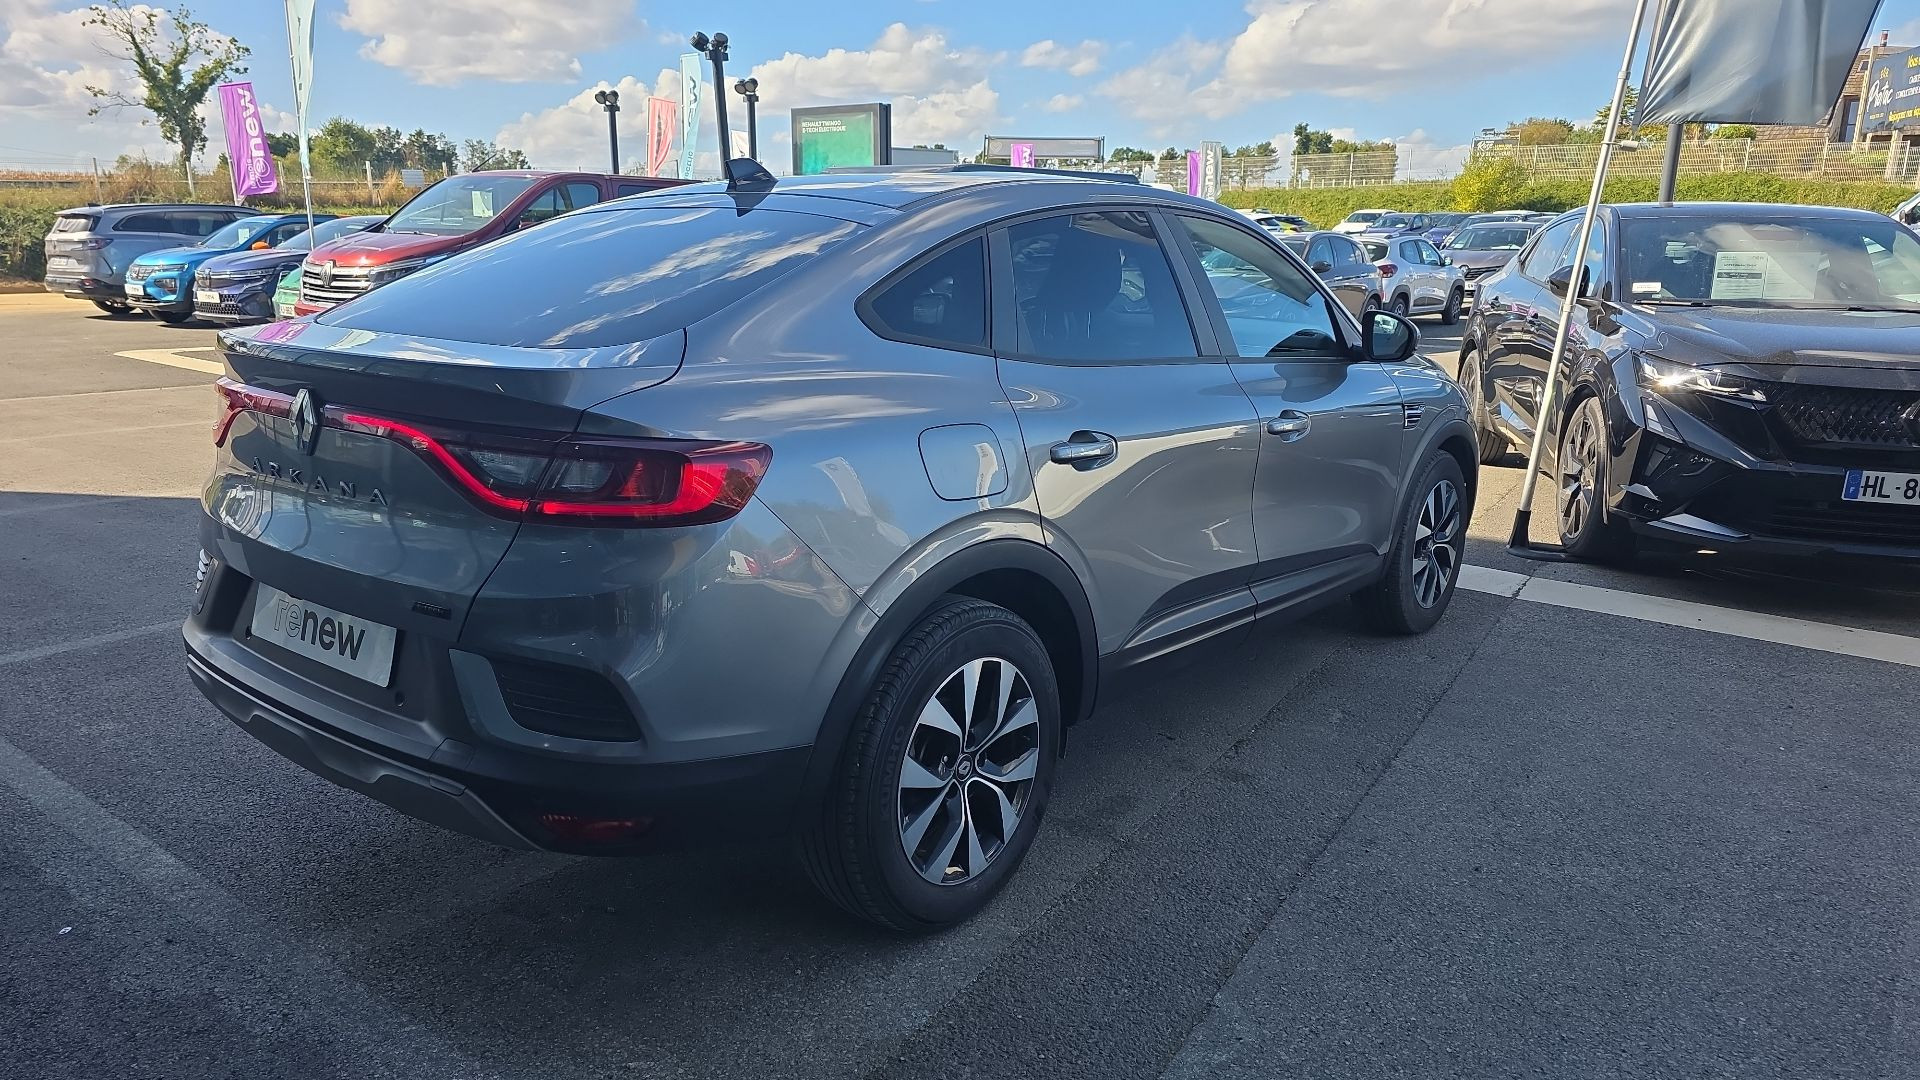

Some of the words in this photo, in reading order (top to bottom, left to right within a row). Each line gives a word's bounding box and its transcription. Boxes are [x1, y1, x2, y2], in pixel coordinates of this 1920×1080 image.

[237, 88, 275, 189] renew
[252, 456, 388, 506] ARKANA
[1862, 475, 1920, 500] HL-8
[273, 598, 366, 661] renew
